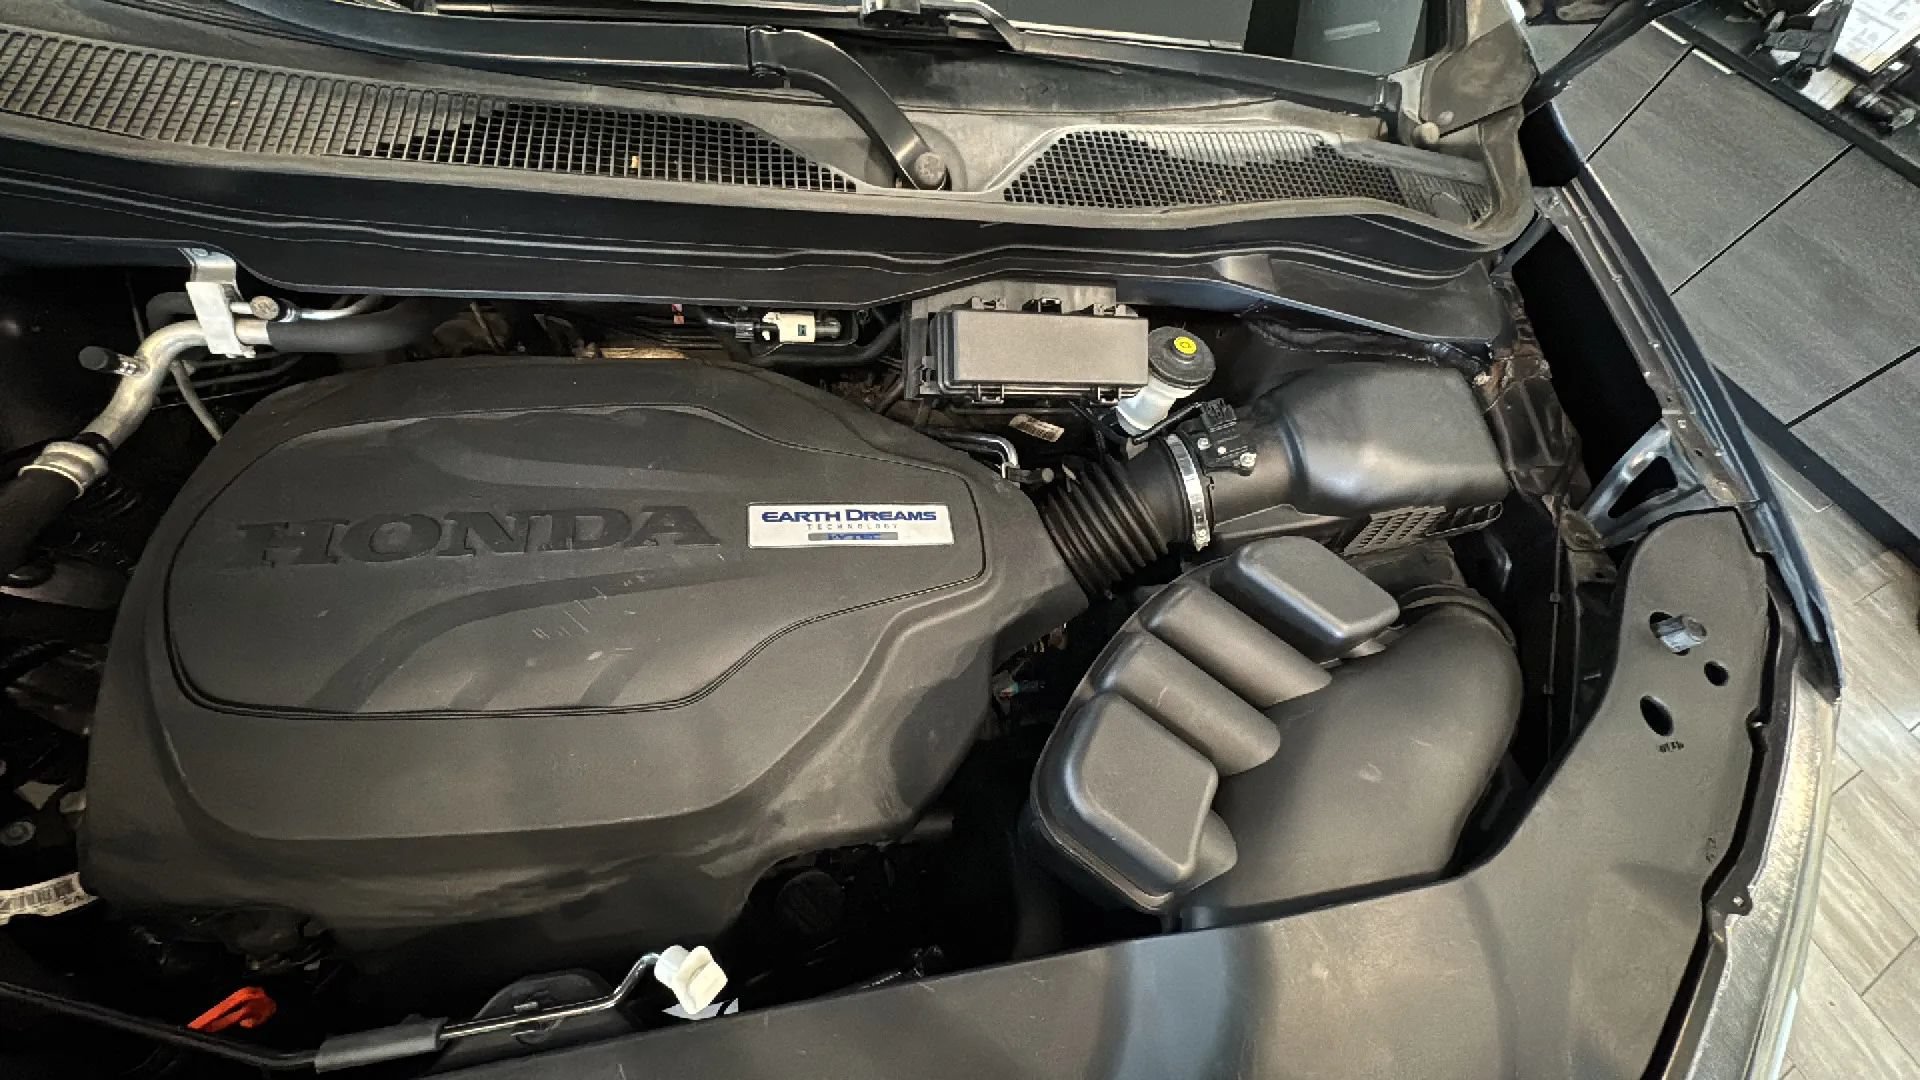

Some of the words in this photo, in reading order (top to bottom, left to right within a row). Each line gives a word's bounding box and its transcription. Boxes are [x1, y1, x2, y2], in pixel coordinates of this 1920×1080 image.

[761, 511, 841, 522] EARTH
[845, 509, 937, 521] DREAMS
[237, 506, 721, 567] HONDA
